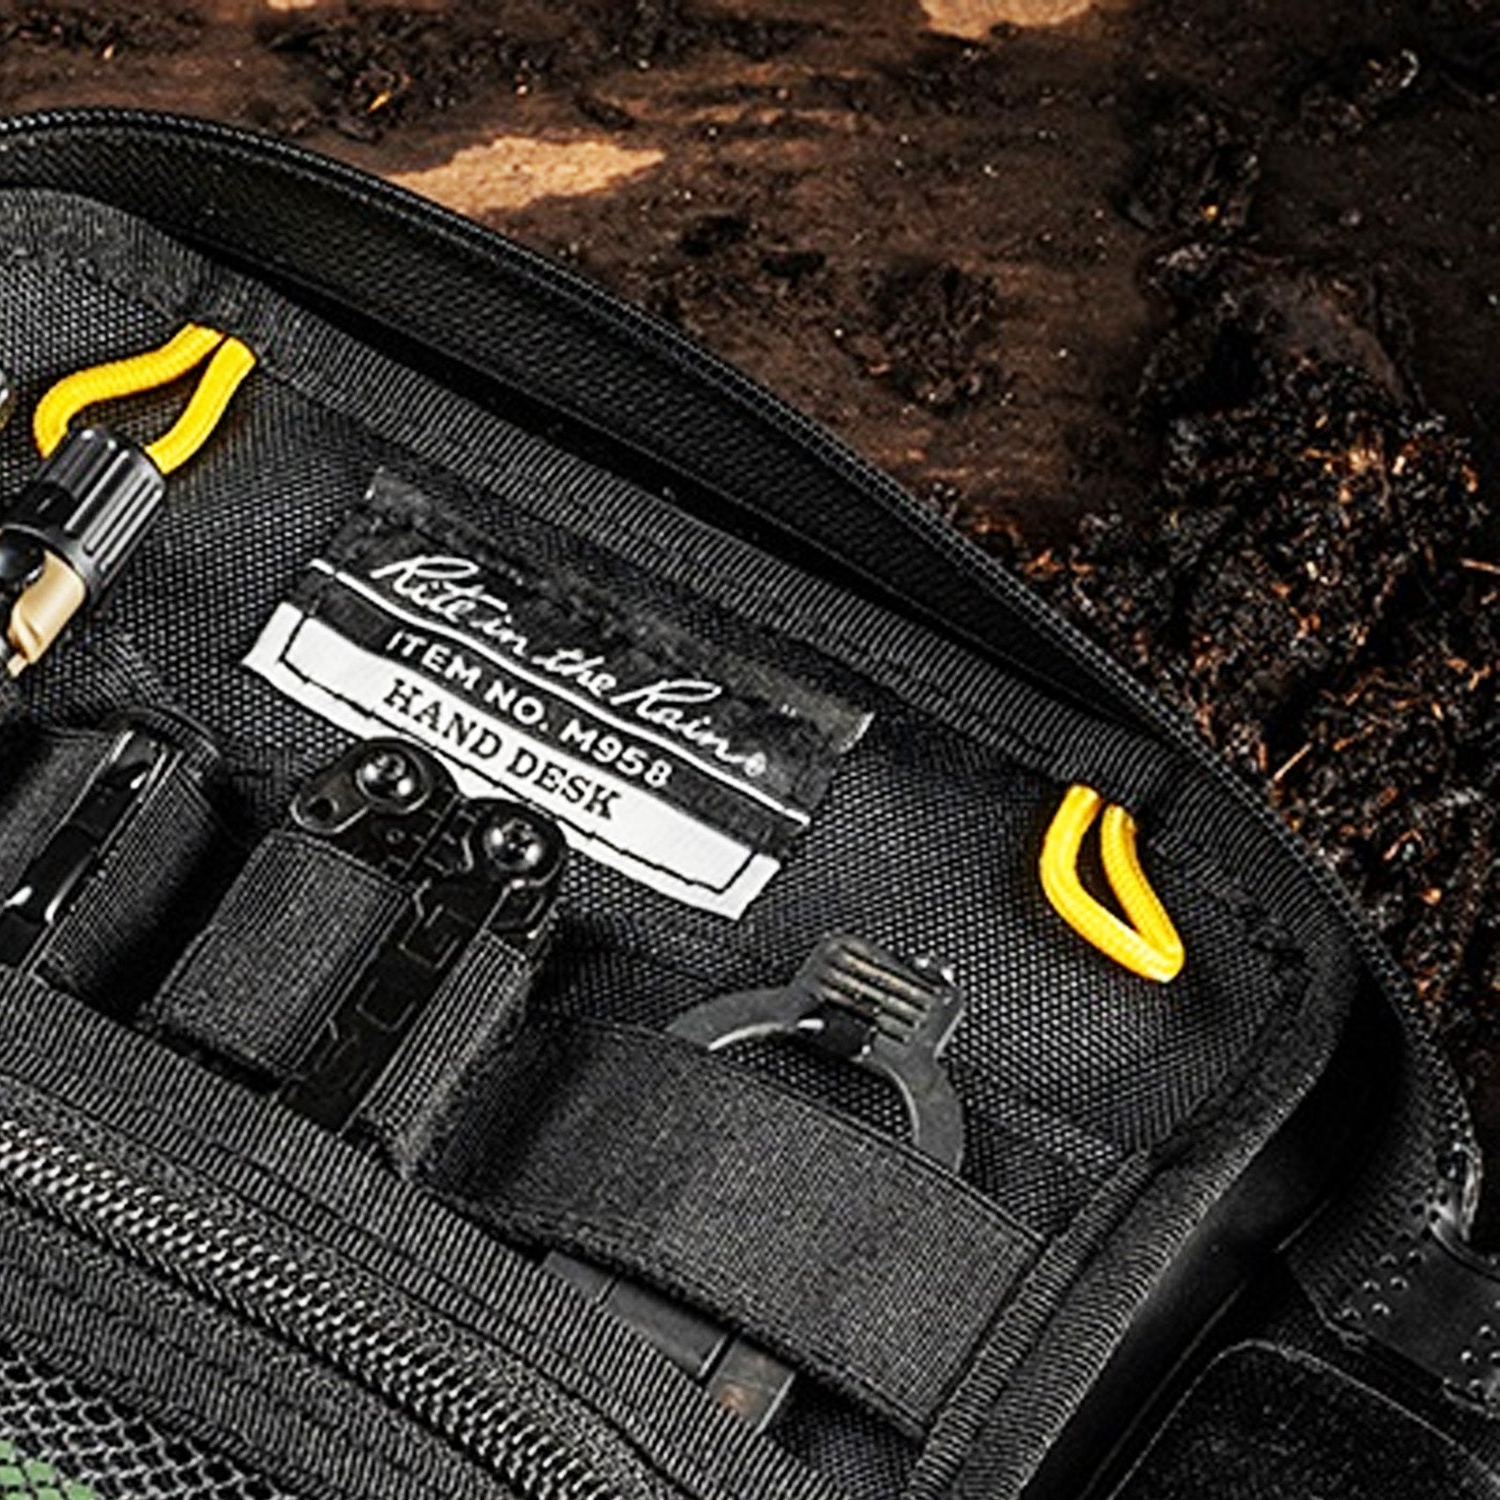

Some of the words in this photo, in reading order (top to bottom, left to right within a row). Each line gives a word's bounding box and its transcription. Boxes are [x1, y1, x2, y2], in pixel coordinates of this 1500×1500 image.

[386, 631, 483, 689] ITEM
[484, 679, 550, 731] NO.
[558, 718, 674, 789] M958
[469, 614, 530, 657] in
[531, 648, 618, 697] the
[382, 679, 502, 760] HAND
[505, 747, 621, 822] DESK
